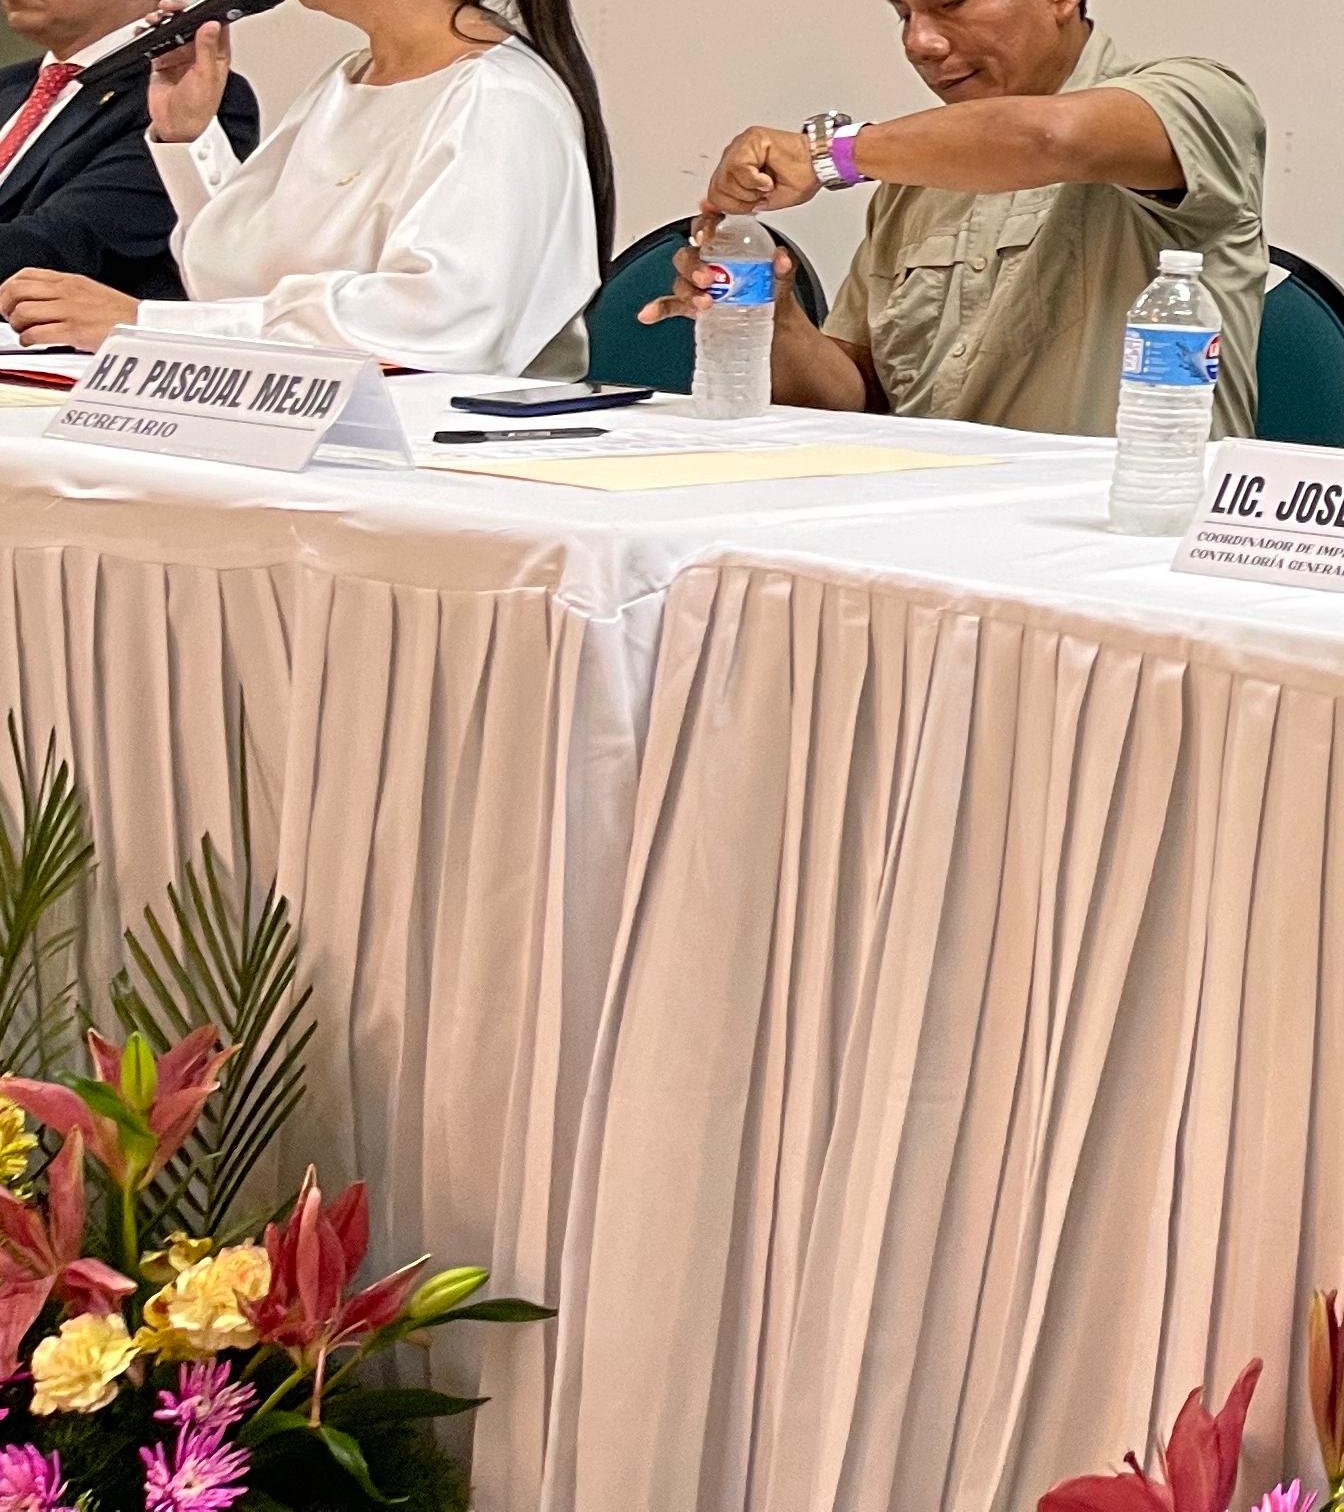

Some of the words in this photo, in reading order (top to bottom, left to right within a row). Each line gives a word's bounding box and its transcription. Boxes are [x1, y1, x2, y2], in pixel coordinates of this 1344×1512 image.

[86, 353, 138, 394] H.R.
[135, 359, 253, 408] PASCUAL
[247, 373, 342, 419] MEJIA
[61, 408, 178, 438] SECRETARIO
[1210, 473, 1264, 518] LIC.
[1197, 531, 1292, 552] COORDINADOR
[1296, 542, 1315, 555] DE
[1190, 548, 1285, 569] CONTRALORÍA
